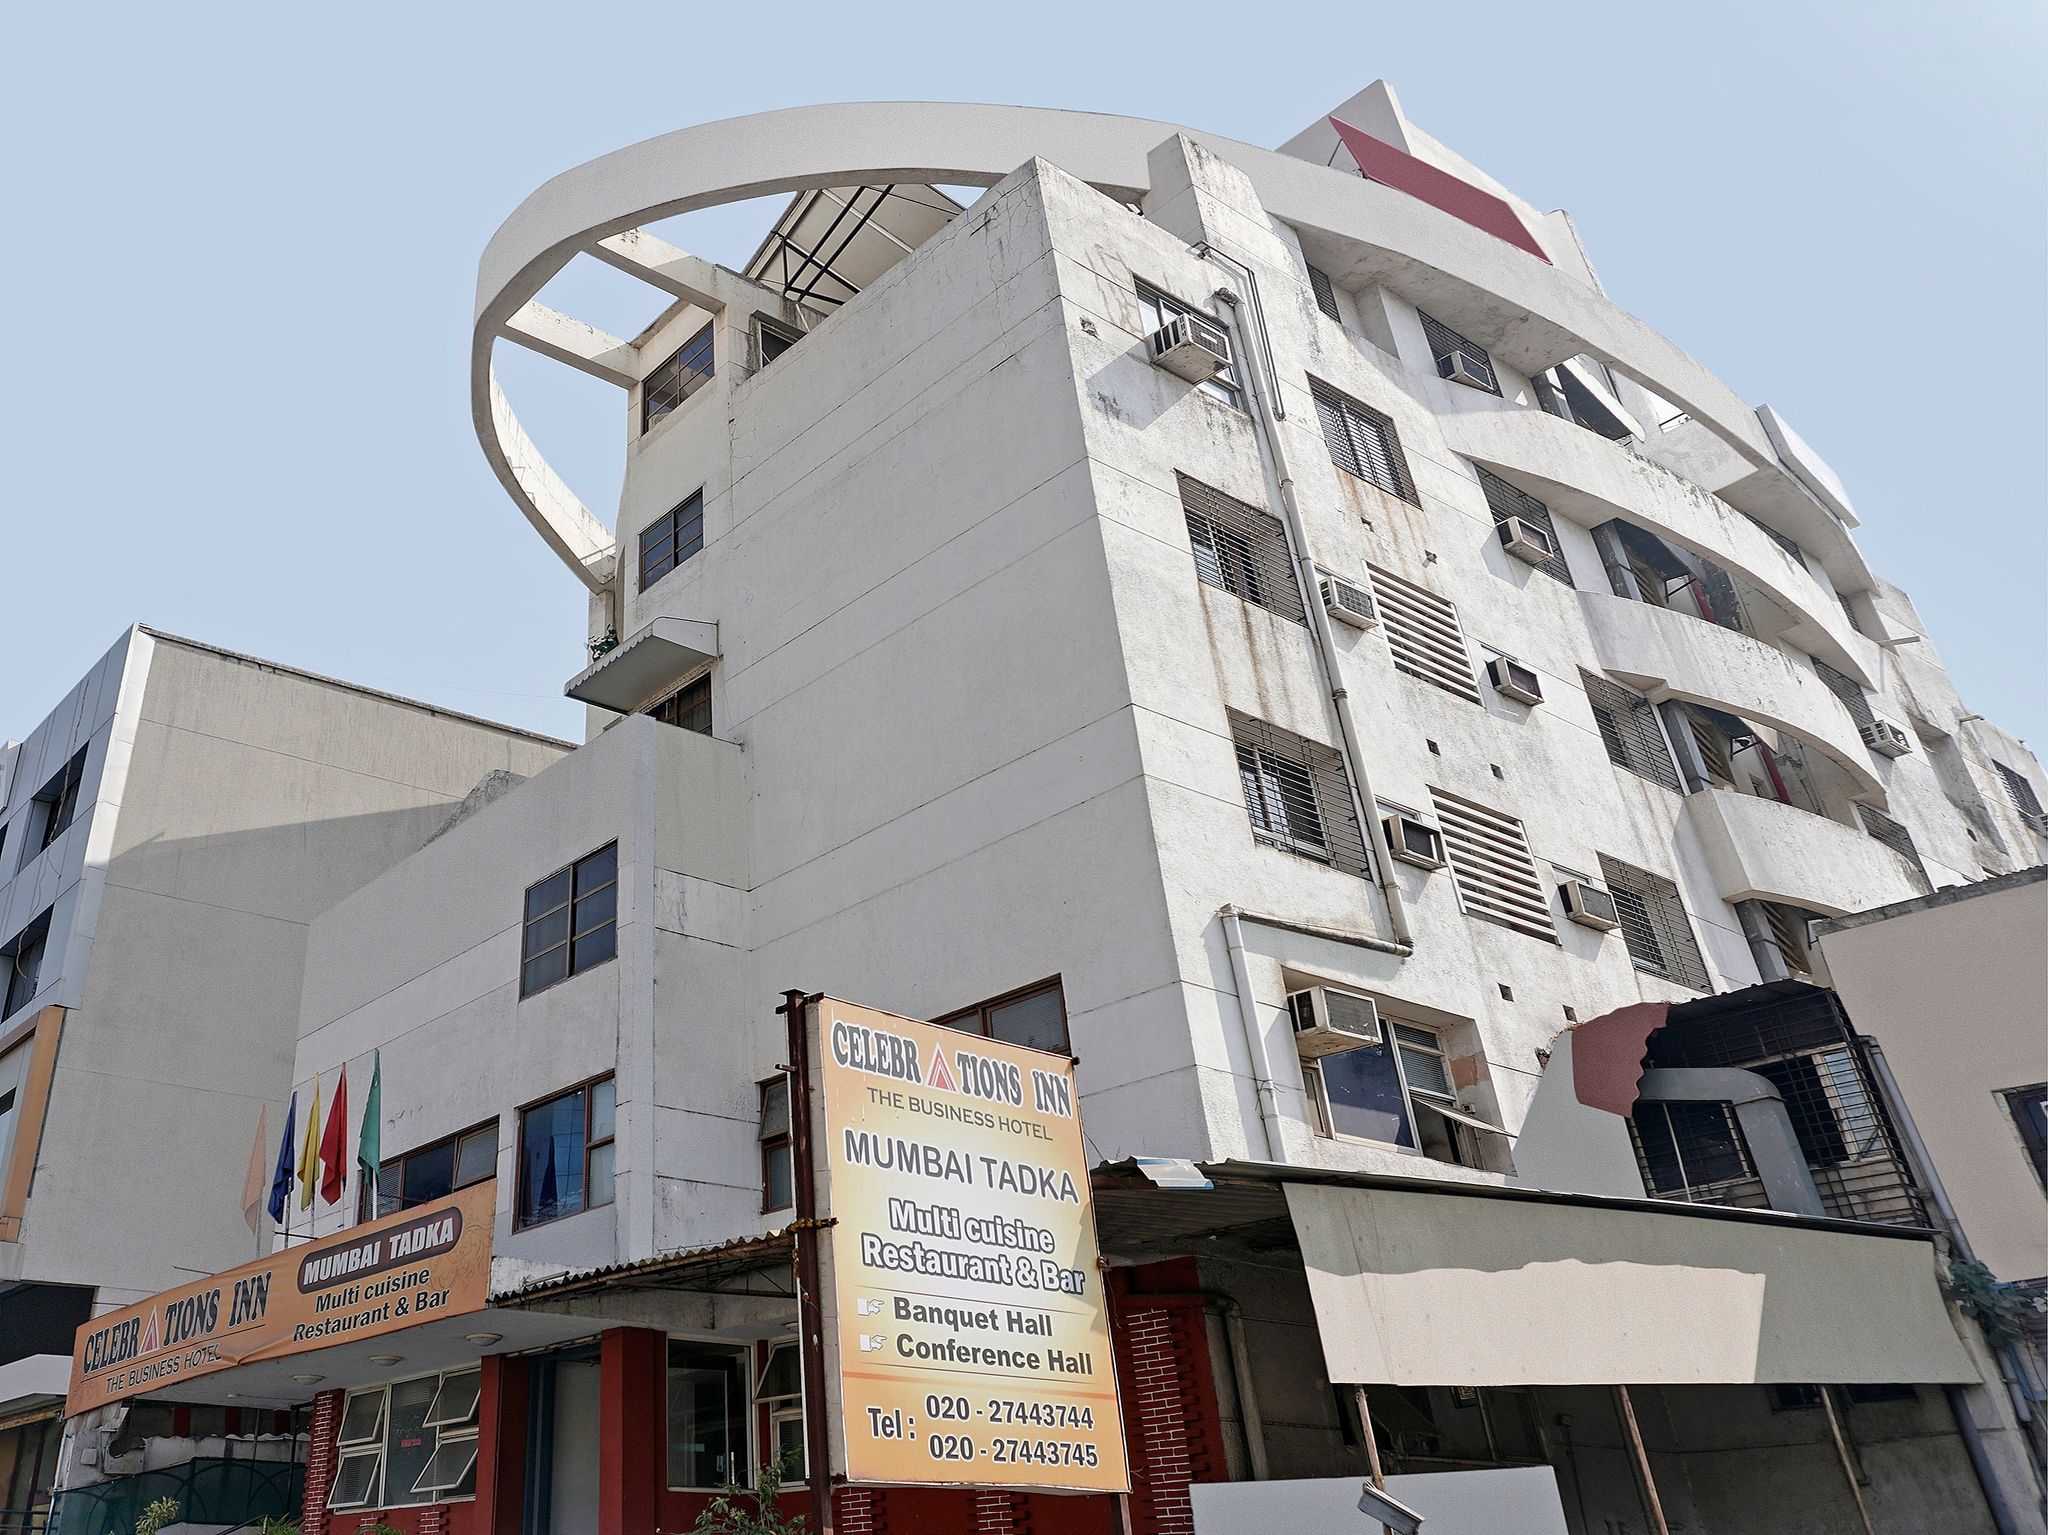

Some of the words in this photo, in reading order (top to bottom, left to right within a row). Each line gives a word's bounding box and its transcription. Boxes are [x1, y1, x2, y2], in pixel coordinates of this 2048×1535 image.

[867, 1087, 905, 1110] THE
[910, 1096, 994, 1127] BUSINESS
[998, 1116, 1053, 1140] HOTEL
[1033, 1070, 1072, 1118] INN
[844, 1130, 972, 1184] MUMBAI
[980, 1156, 1079, 1204] TADKA
[888, 1198, 960, 1240] Multi
[965, 1216, 1055, 1253] cuisine
[302, 1244, 379, 1287] MUMBAI
[390, 1218, 454, 1259] TADKA
[861, 1234, 1012, 1286] Restaurant
[1015, 1257, 1039, 1288] &
[1042, 1259, 1086, 1295] Bar
[229, 1272, 272, 1327] INN
[293, 1306, 390, 1342] Restaurant
[394, 1296, 409, 1318] &
[415, 1287, 450, 1311] Bar
[316, 1286, 361, 1313] Multi
[364, 1269, 430, 1299] cuisine
[894, 1296, 999, 1332] Banquet
[1007, 1310, 1052, 1337] Hall
[106, 1374, 126, 1394] THE
[128, 1358, 180, 1386] BUSINESS
[184, 1343, 221, 1372] HOTEL
[896, 1333, 1040, 1369] Conference
[1047, 1349, 1092, 1375] Hall
[926, 1395, 970, 1421] 020
[989, 1400, 1093, 1428] 27443744
[929, 1434, 974, 1461] 020
[992, 1438, 1099, 1468] 27443745
